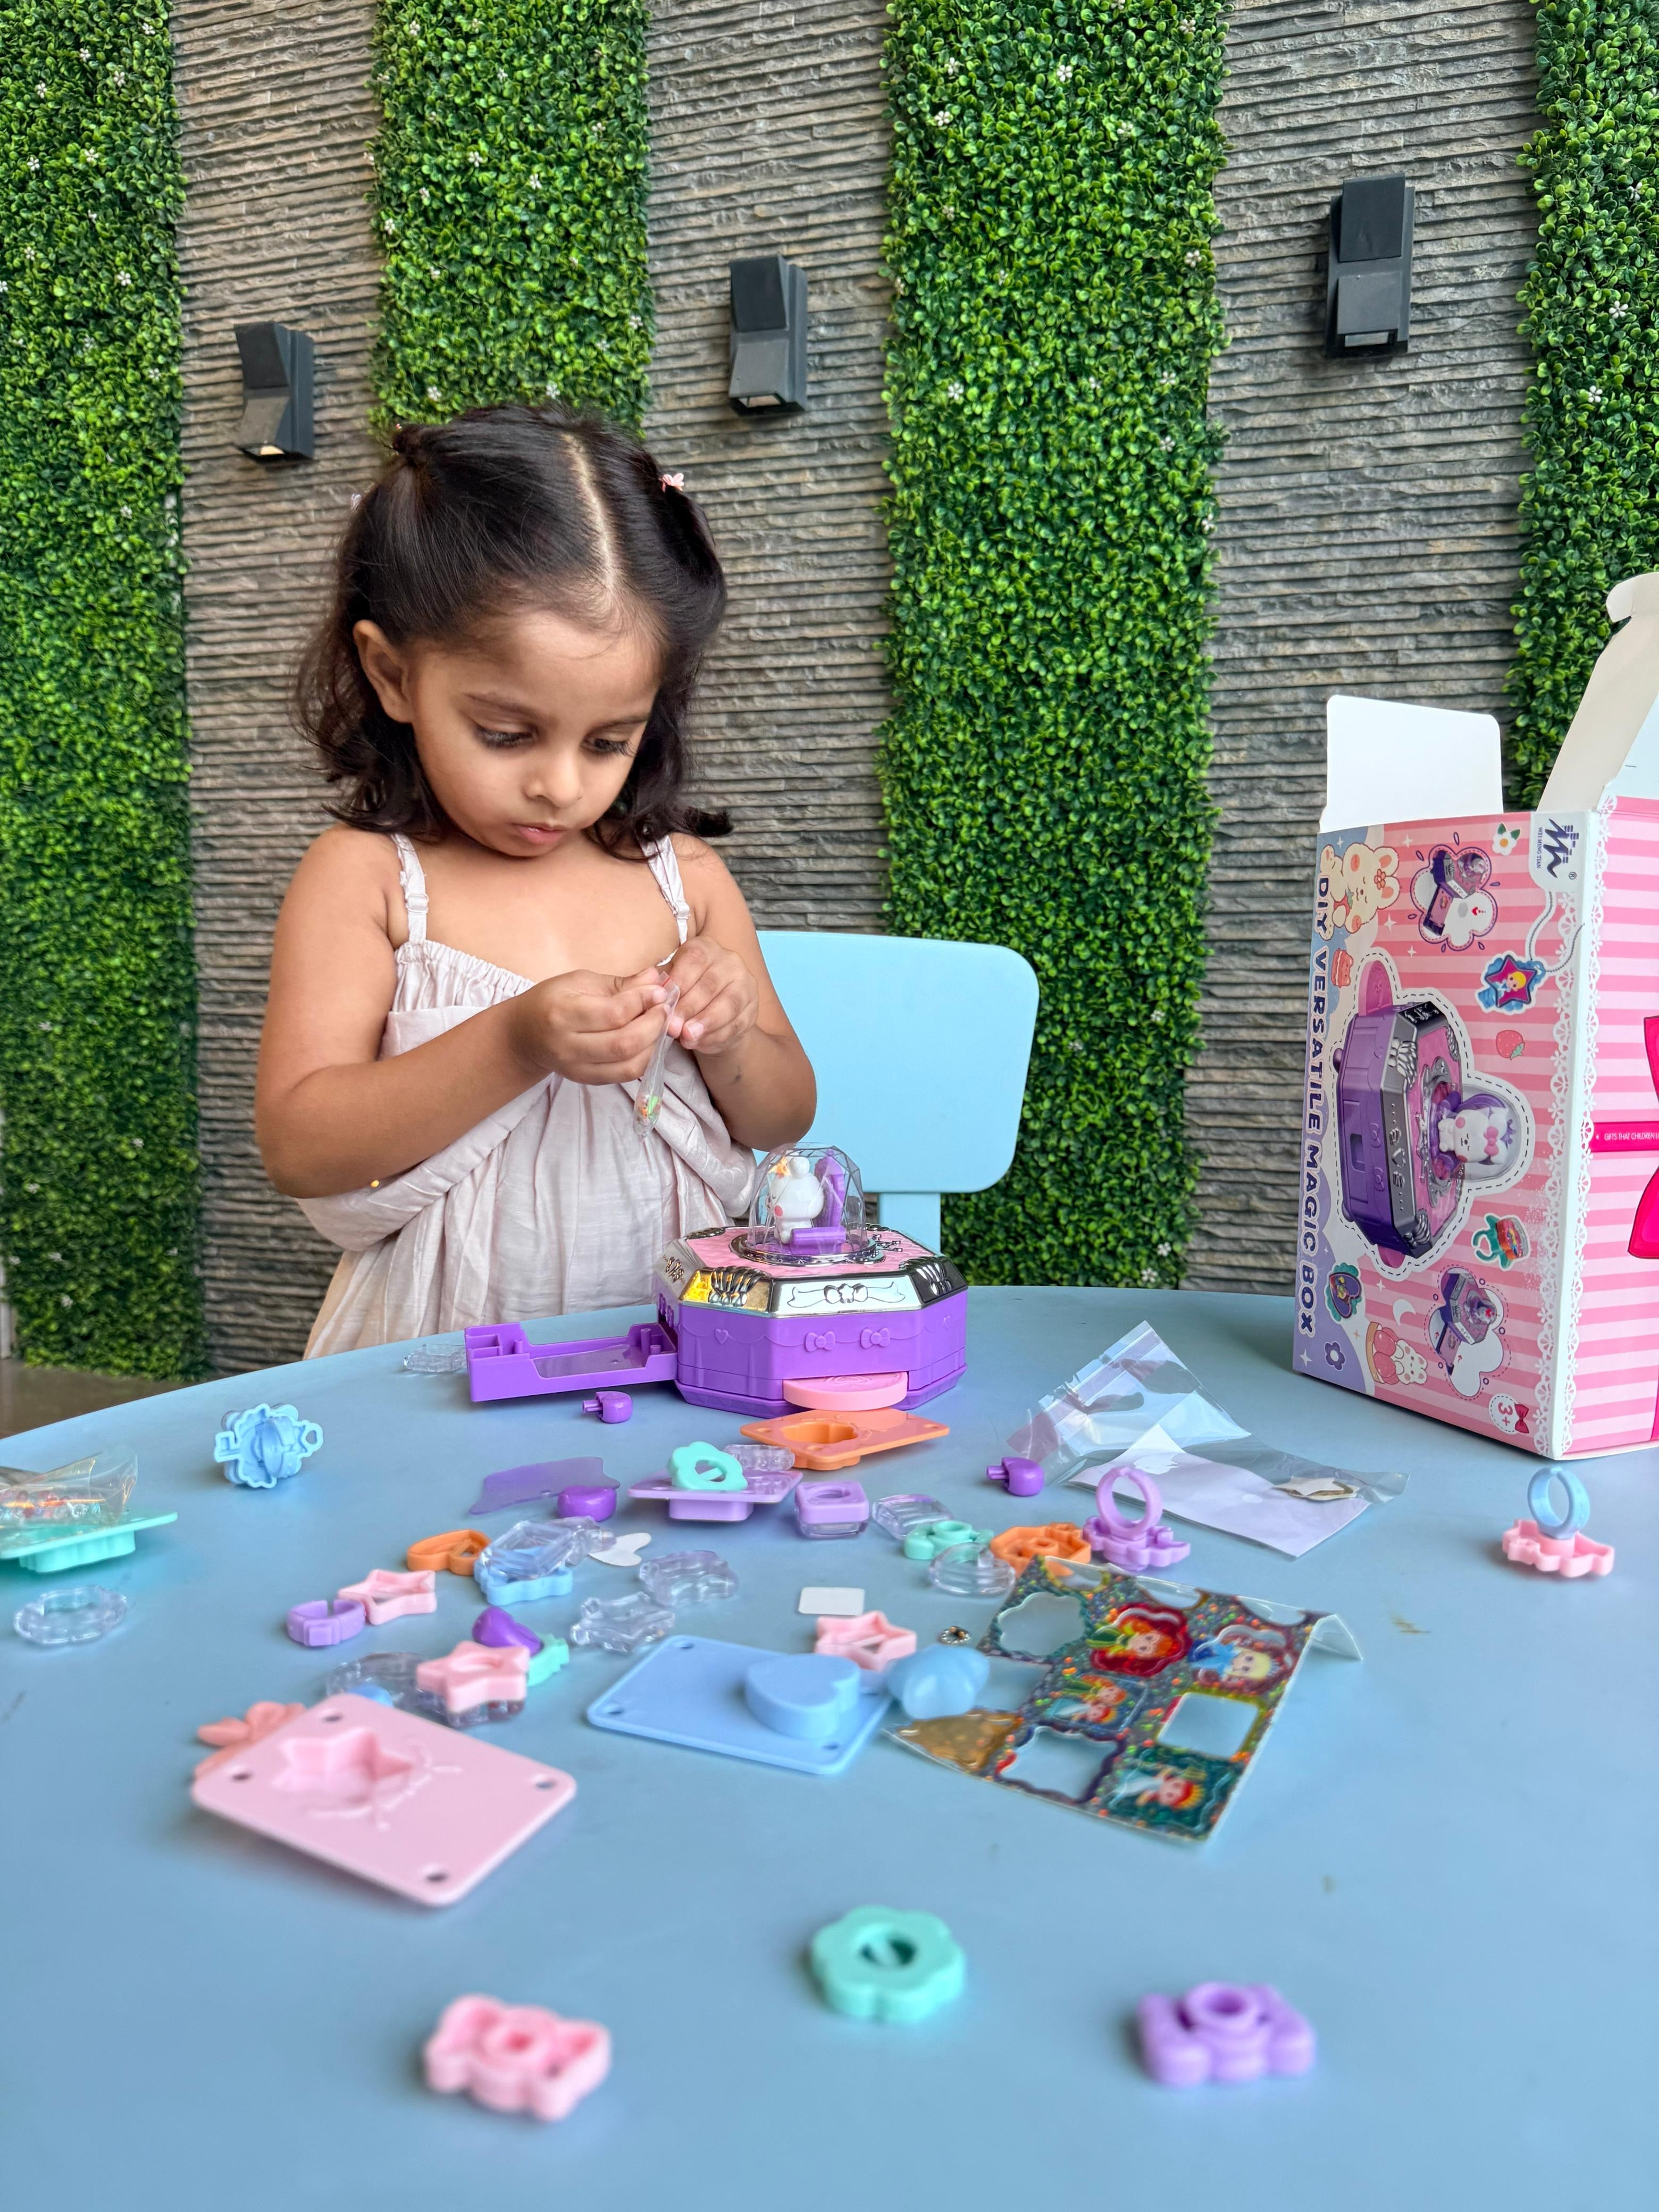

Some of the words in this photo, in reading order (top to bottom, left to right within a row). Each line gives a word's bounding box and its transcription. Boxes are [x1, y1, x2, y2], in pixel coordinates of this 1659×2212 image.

[1317, 878, 1328, 934] DIY
[1309, 951, 1327, 1130] VERSATILE
[1303, 1144, 1319, 1251] MAGIC
[1301, 1264, 1315, 1333] BOX
[1498, 1402, 1513, 1426] 3+
